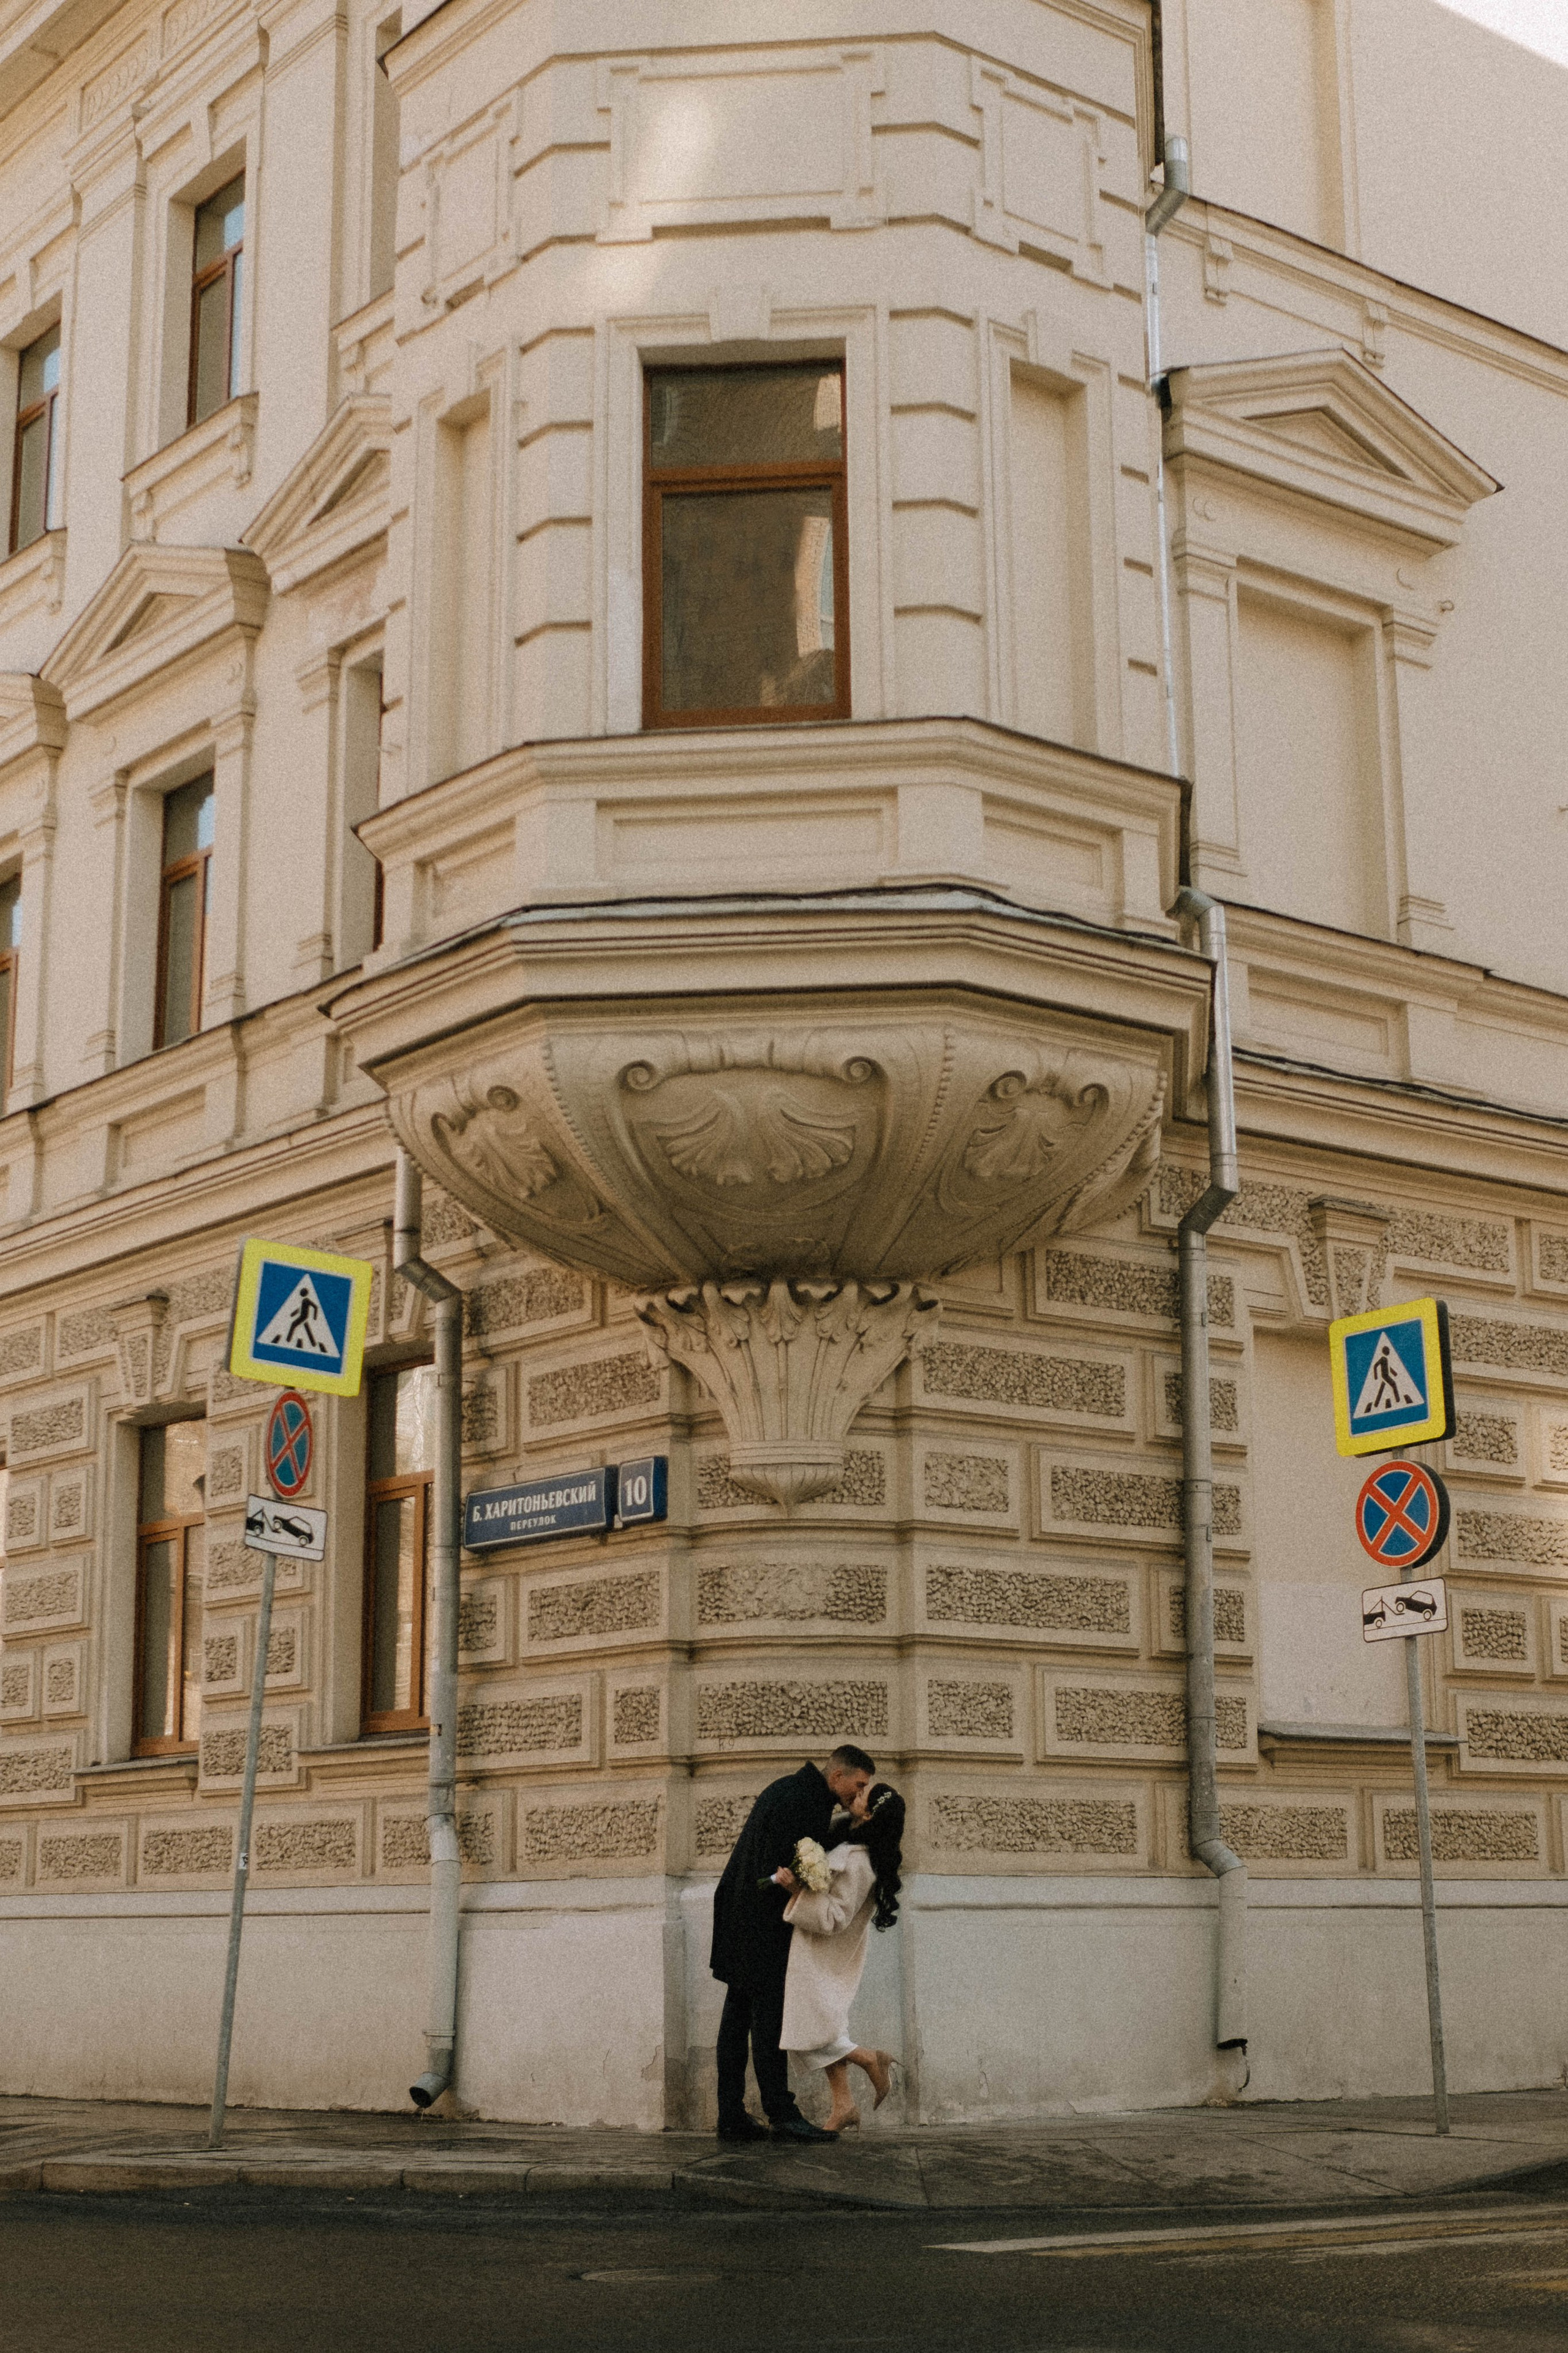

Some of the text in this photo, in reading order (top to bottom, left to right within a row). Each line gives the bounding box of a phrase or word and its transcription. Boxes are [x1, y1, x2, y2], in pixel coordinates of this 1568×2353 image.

[472, 1481, 597, 1522] Б. ХАРИТОНЬЕВСКИЙ
[624, 1475, 647, 1506] 10
[510, 1514, 557, 1531] ПЕРЕУЛОК
